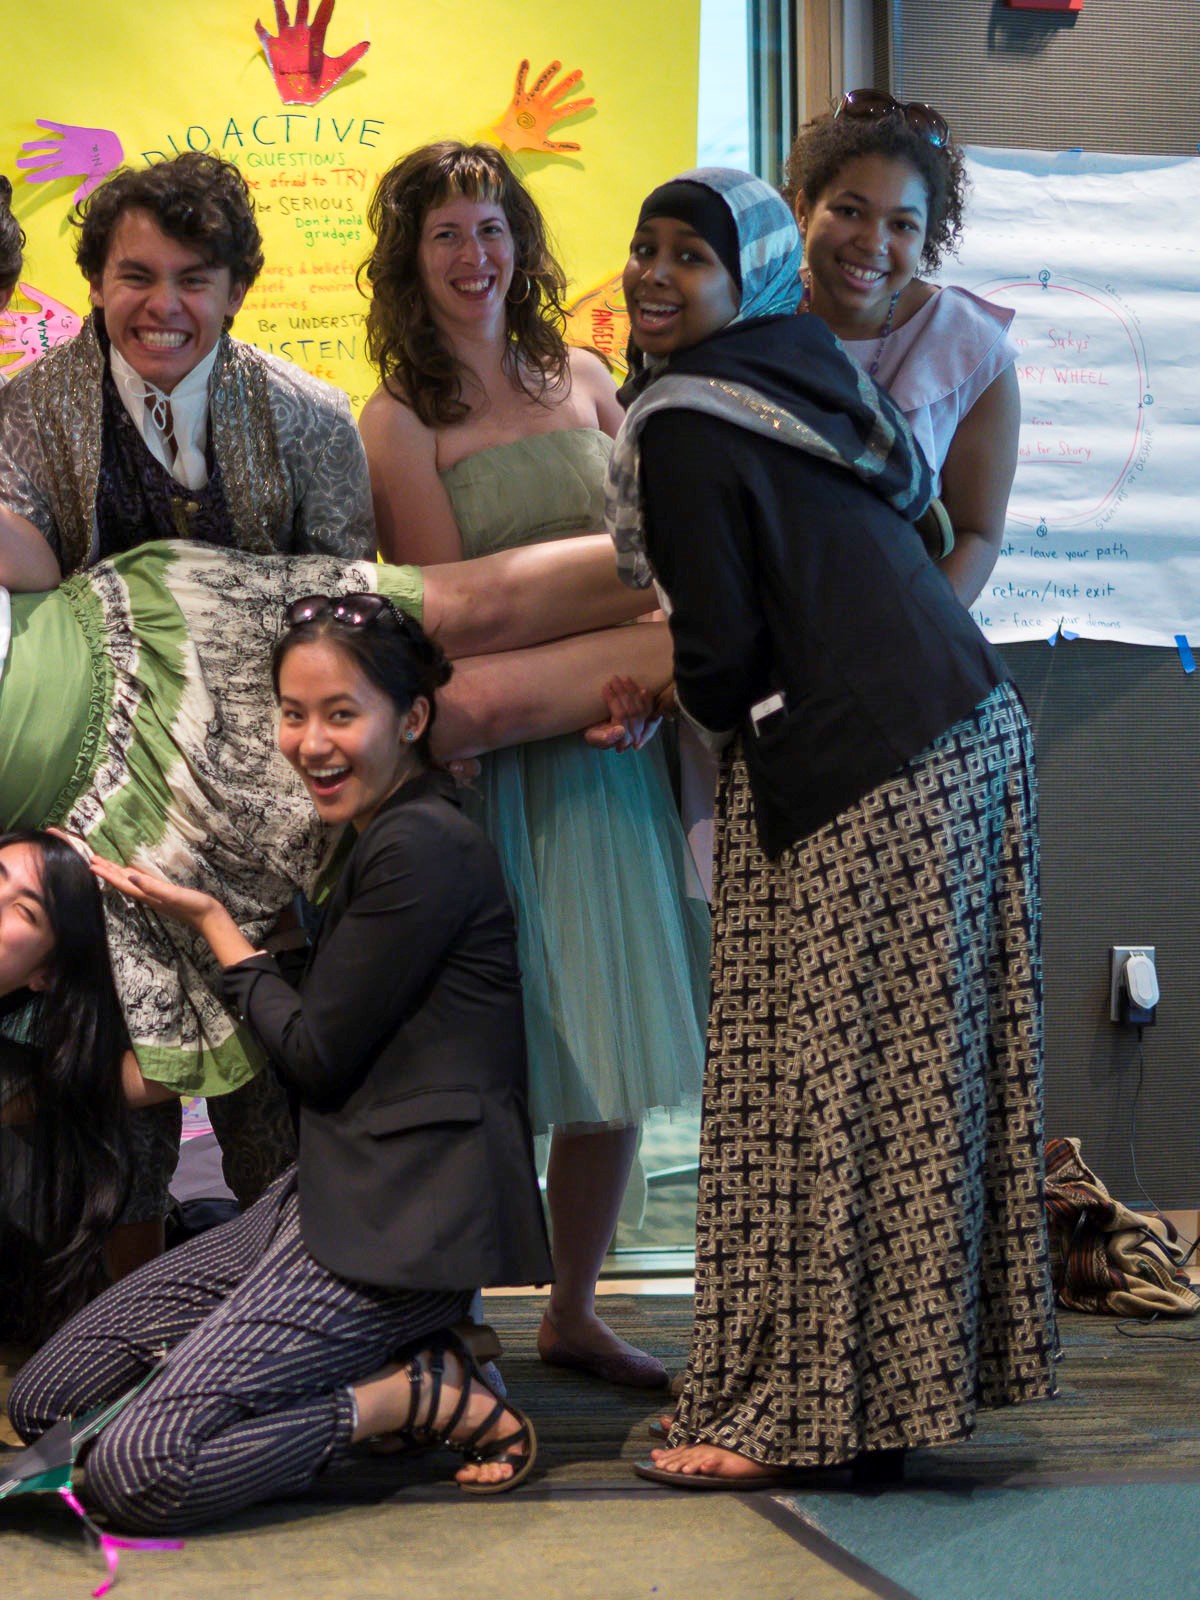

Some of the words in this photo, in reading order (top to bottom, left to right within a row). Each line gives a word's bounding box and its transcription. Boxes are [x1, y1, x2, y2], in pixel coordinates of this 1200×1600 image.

[246, 152, 345, 167] QUESTIONS
[331, 168, 367, 192] TRY
[279, 196, 354, 215] SERIOUS
[338, 215, 363, 226] hold
[304, 228, 361, 247] grudges
[258, 320, 278, 333] Be
[1053, 368, 1109, 385] WHEEL
[1058, 440, 1092, 460] Story
[1030, 546, 1059, 559] leave
[1065, 550, 1089, 561] your
[1096, 542, 1128, 561] path
[1086, 584, 1116, 598] exit
